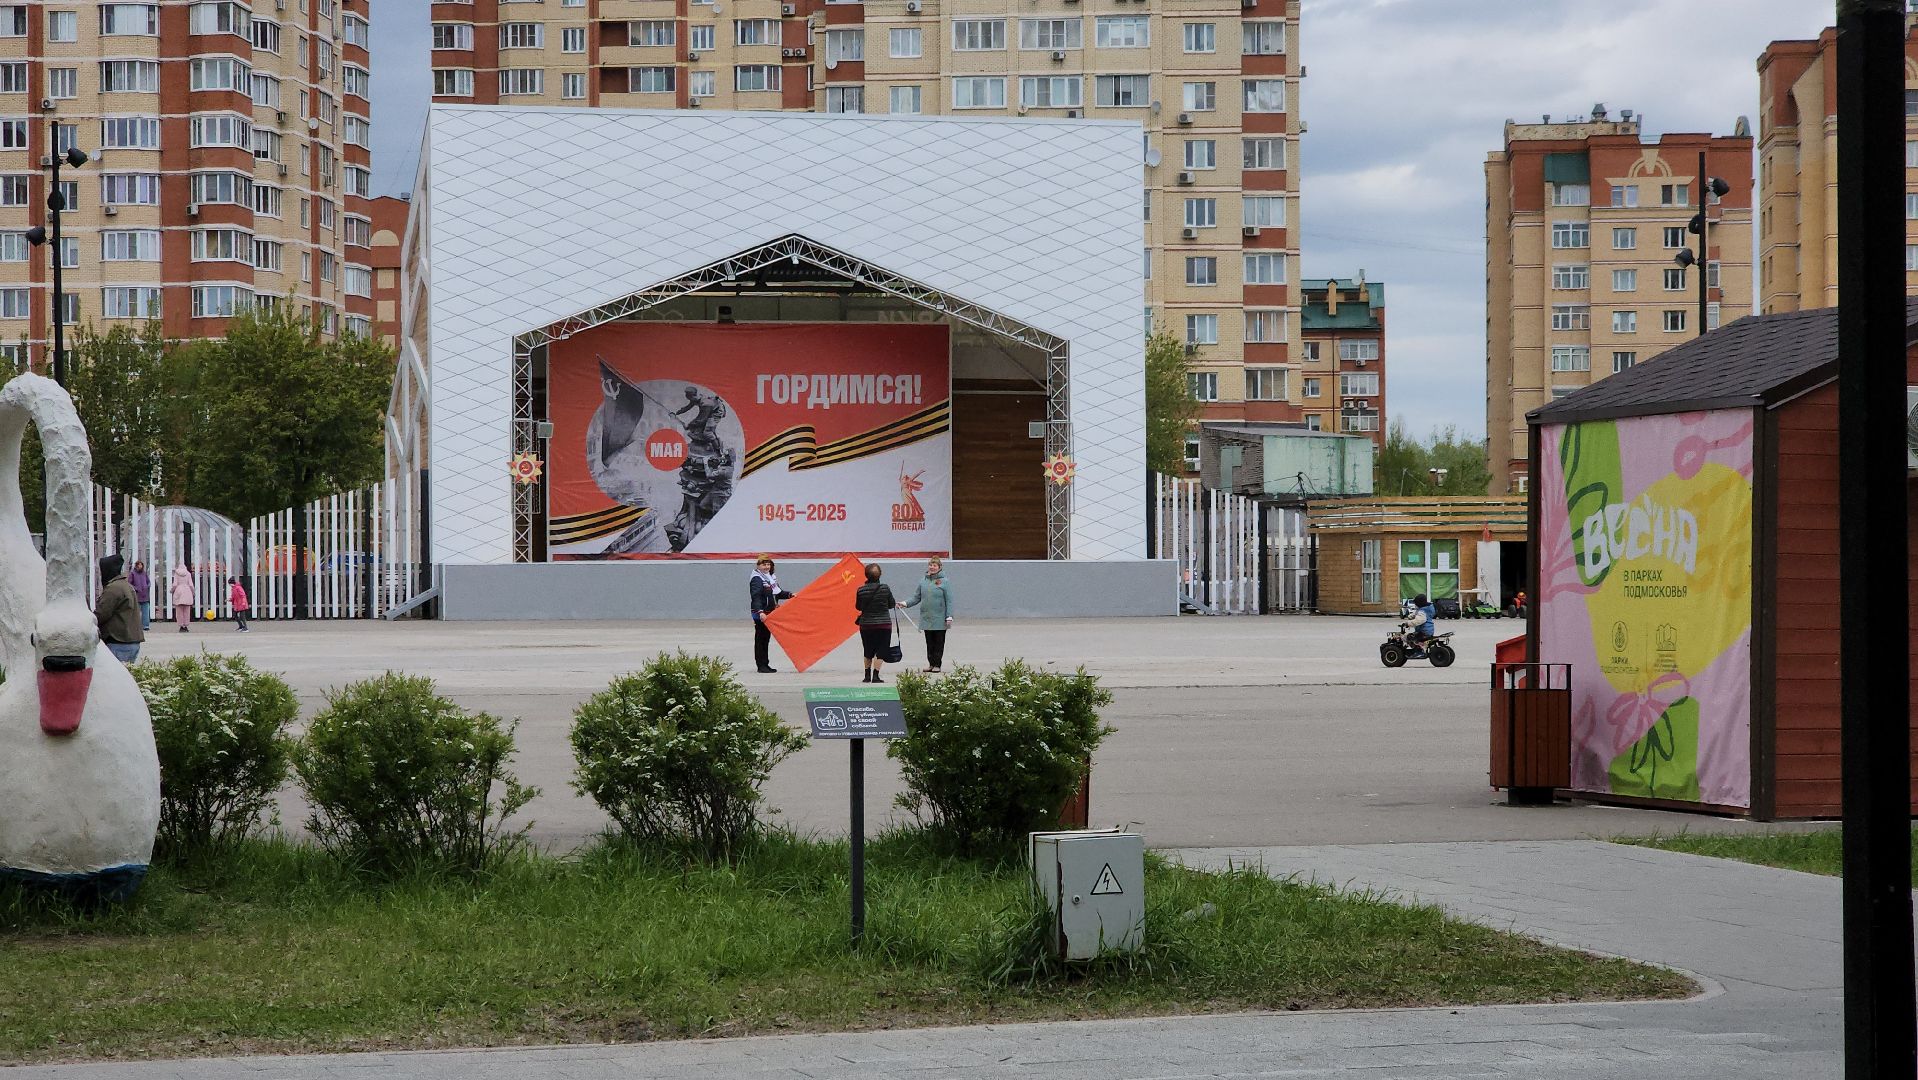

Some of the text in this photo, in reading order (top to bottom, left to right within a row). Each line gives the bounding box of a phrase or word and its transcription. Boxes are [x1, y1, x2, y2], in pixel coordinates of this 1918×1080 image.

[756, 373, 923, 410] ГОРДИМСЯ!
[650, 443, 683, 458] МАЯ
[891, 503, 913, 522] 80
[891, 522, 926, 532] ПОБЕДА!
[1623, 570, 1663, 582] В ПАРКАХ
[1623, 585, 1687, 598] ПОДМОСКОВЬЯ
